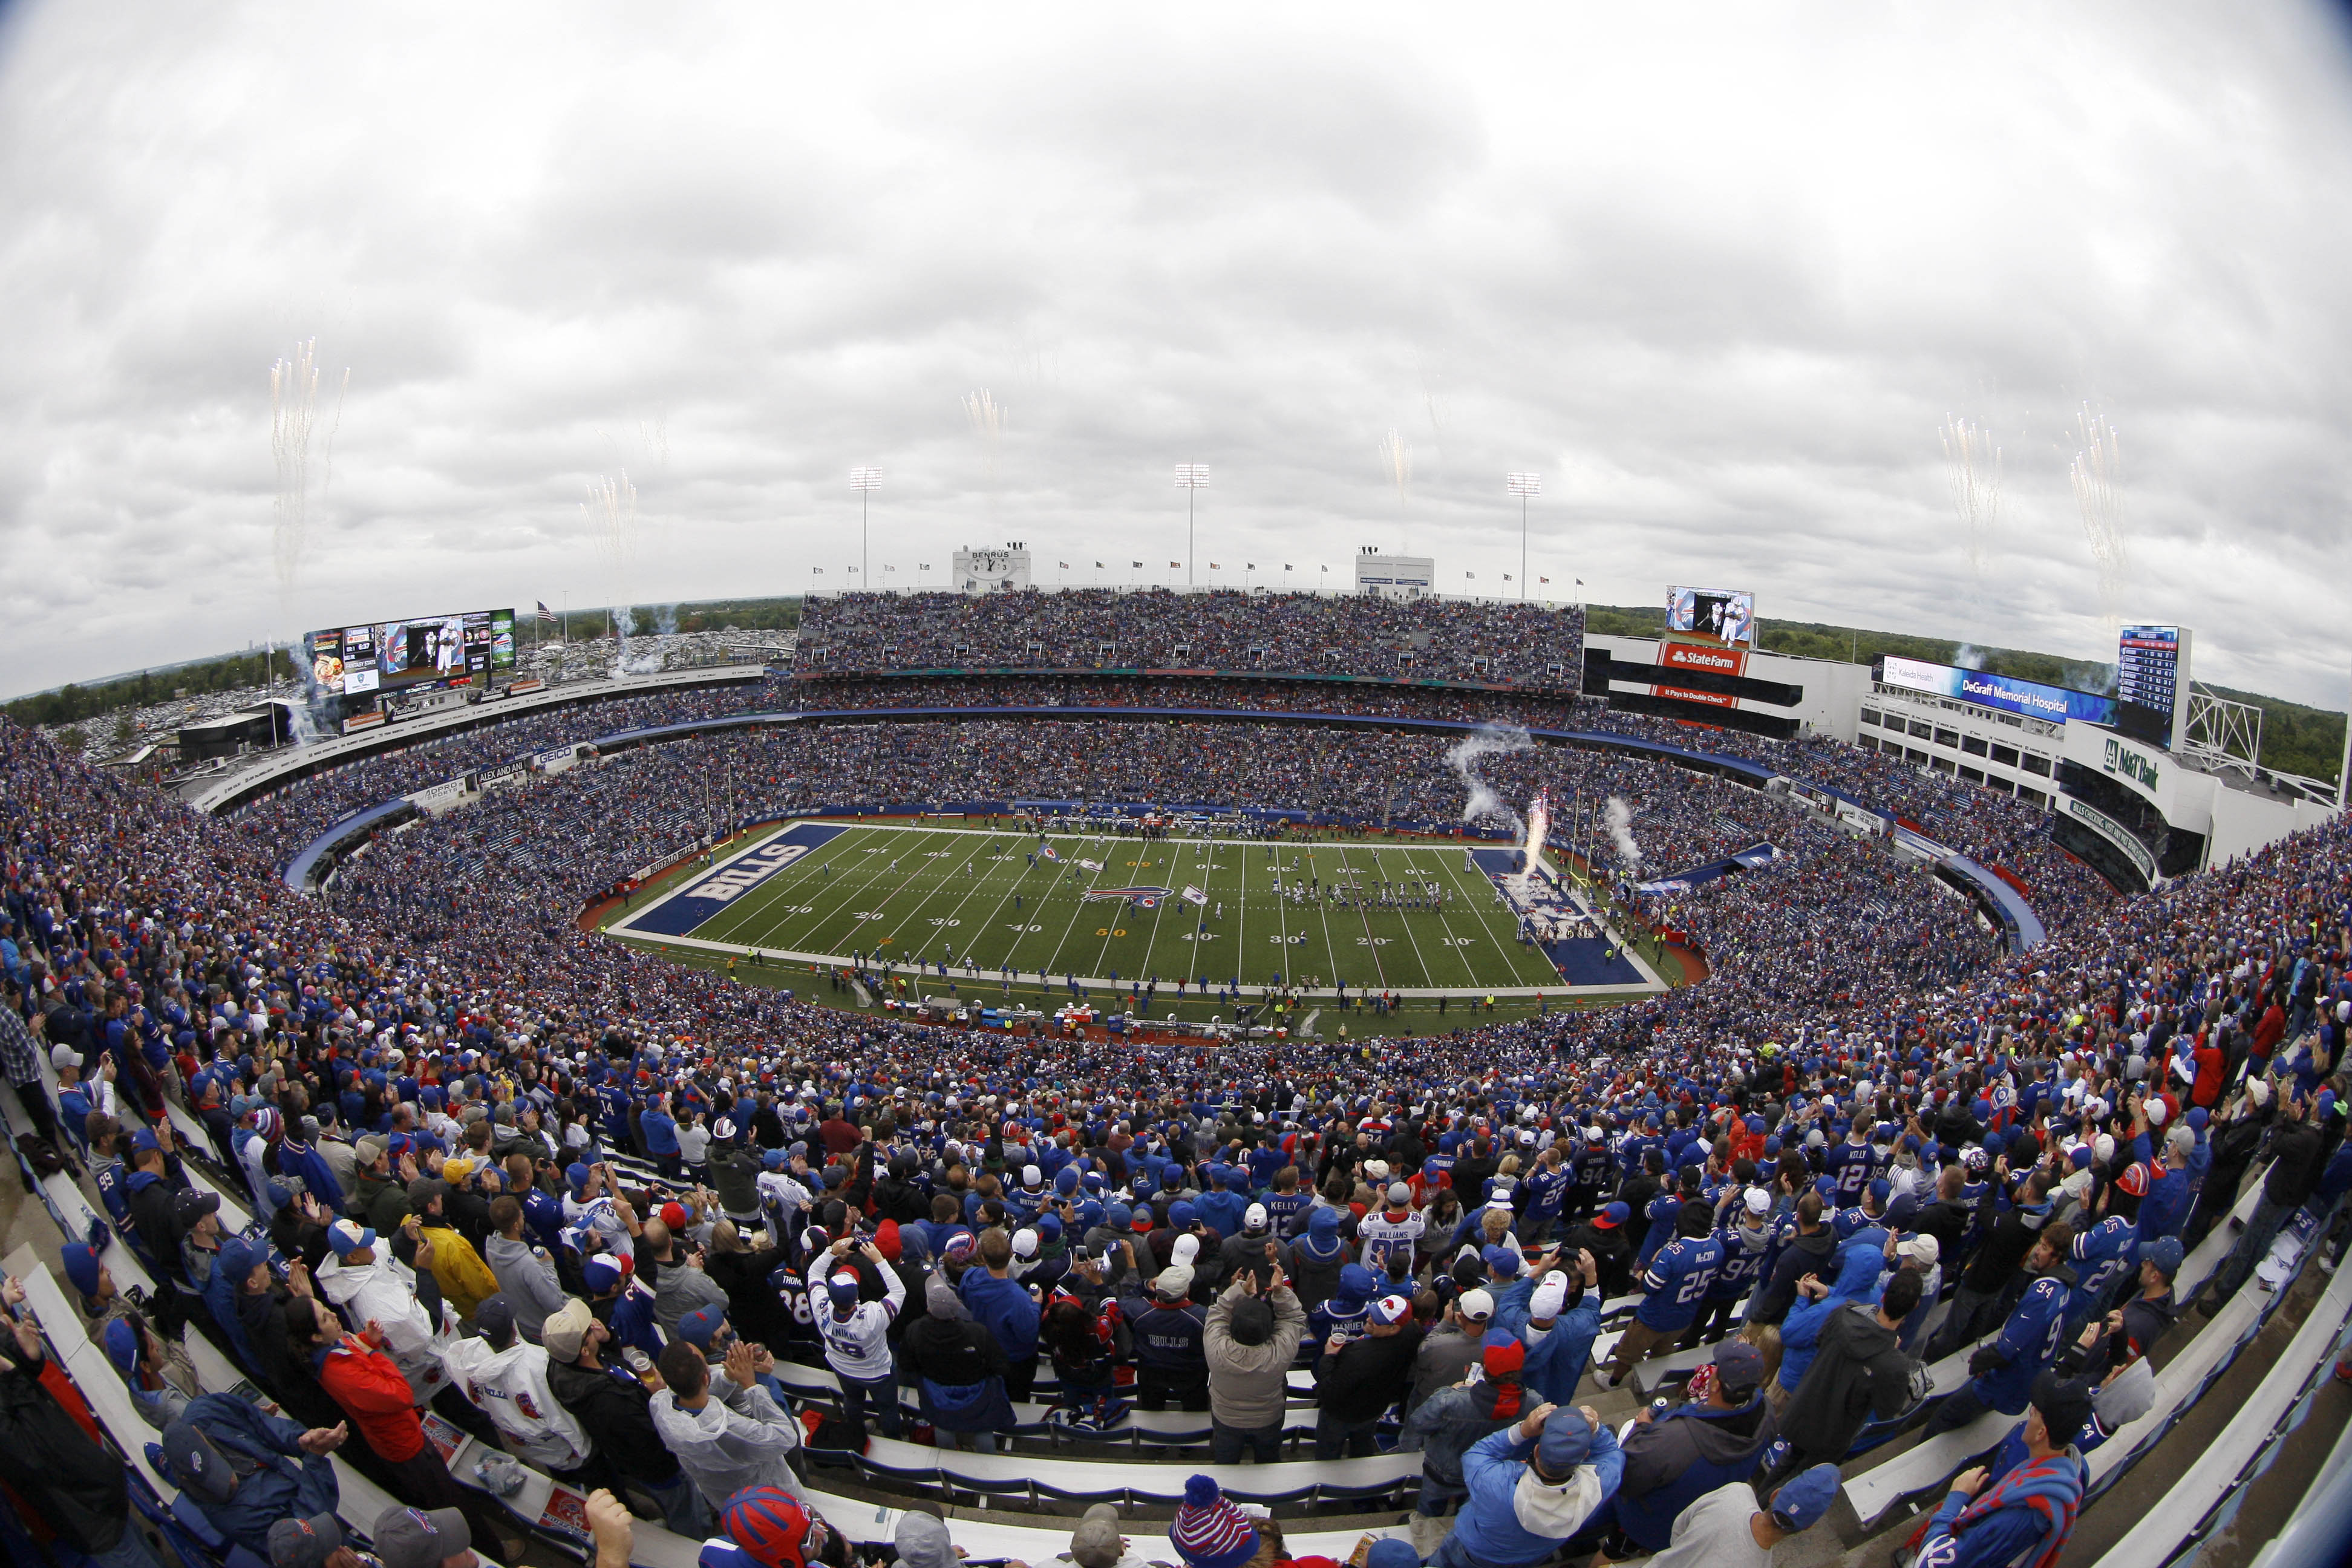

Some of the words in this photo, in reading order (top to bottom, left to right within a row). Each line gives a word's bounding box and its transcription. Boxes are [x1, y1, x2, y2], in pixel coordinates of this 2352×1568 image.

[1687, 652, 1734, 668] StateFarm
[1898, 669, 1916, 681] Kaleida
[1916, 671, 1933, 682] Health
[482, 687, 503, 696] FanDuel
[1962, 679, 1992, 697] DeGraff
[1994, 687, 2030, 705] Memorial
[2032, 696, 2067, 714] Hospital
[393, 704, 417, 716] FanDuel
[540, 746, 572, 764] GEICO
[480, 770, 496, 783] ALEX
[497, 766, 511, 779] AND
[511, 762, 523, 774] ANI
[2118, 747, 2140, 779] M&T
[2139, 756, 2158, 792] Bank
[425, 782, 458, 795] ADPRO
[427, 788, 458, 800] SPORTS
[2073, 803, 2085, 815] BILLS
[1865, 813, 1879, 823] WHERE
[650, 854, 677, 874] BUFFALO
[677, 845, 695, 860] BILLS
[685, 843, 809, 901] BILLS
[792, 906, 814, 914] 10
[859, 912, 885, 921] 20
[930, 918, 961, 927] 30
[1010, 924, 1042, 932] 40
[1096, 928, 1127, 937] 50
[1181, 933, 1214, 941] 40
[1270, 935, 1300, 944] 30
[1440, 938, 1471, 946] 10
[601, 1100, 615, 1116] 14
[1849, 1150, 1866, 1160] KELLY
[99, 1171, 115, 1192] 99
[1550, 1177, 1567, 1187] JACKSON
[1579, 1168, 1604, 1184] 94
[1837, 1165, 1866, 1192] 12
[528, 1193, 542, 1209] 14
[1541, 1183, 1567, 1207] 22
[1665, 1195, 1676, 1204] 14
[1270, 1201, 1298, 1210] KELLY
[1848, 1210, 1862, 1224] 25
[2104, 1218, 2120, 1235] 25
[1668, 1241, 1684, 1256] 25
[1695, 1250, 1716, 1264] McCOY
[1721, 1258, 1759, 1282] 94
[1676, 1267, 1716, 1303] 25
[2036, 1280, 2054, 1299] 94
[1332, 1321, 1364, 1331] MANUEL
[1148, 1333, 1189, 1348] BILLS
[2082, 1423, 2095, 1440] 94
[546, 1514, 585, 1535] BUFFALO
[1929, 1537, 1958, 1568] 12
